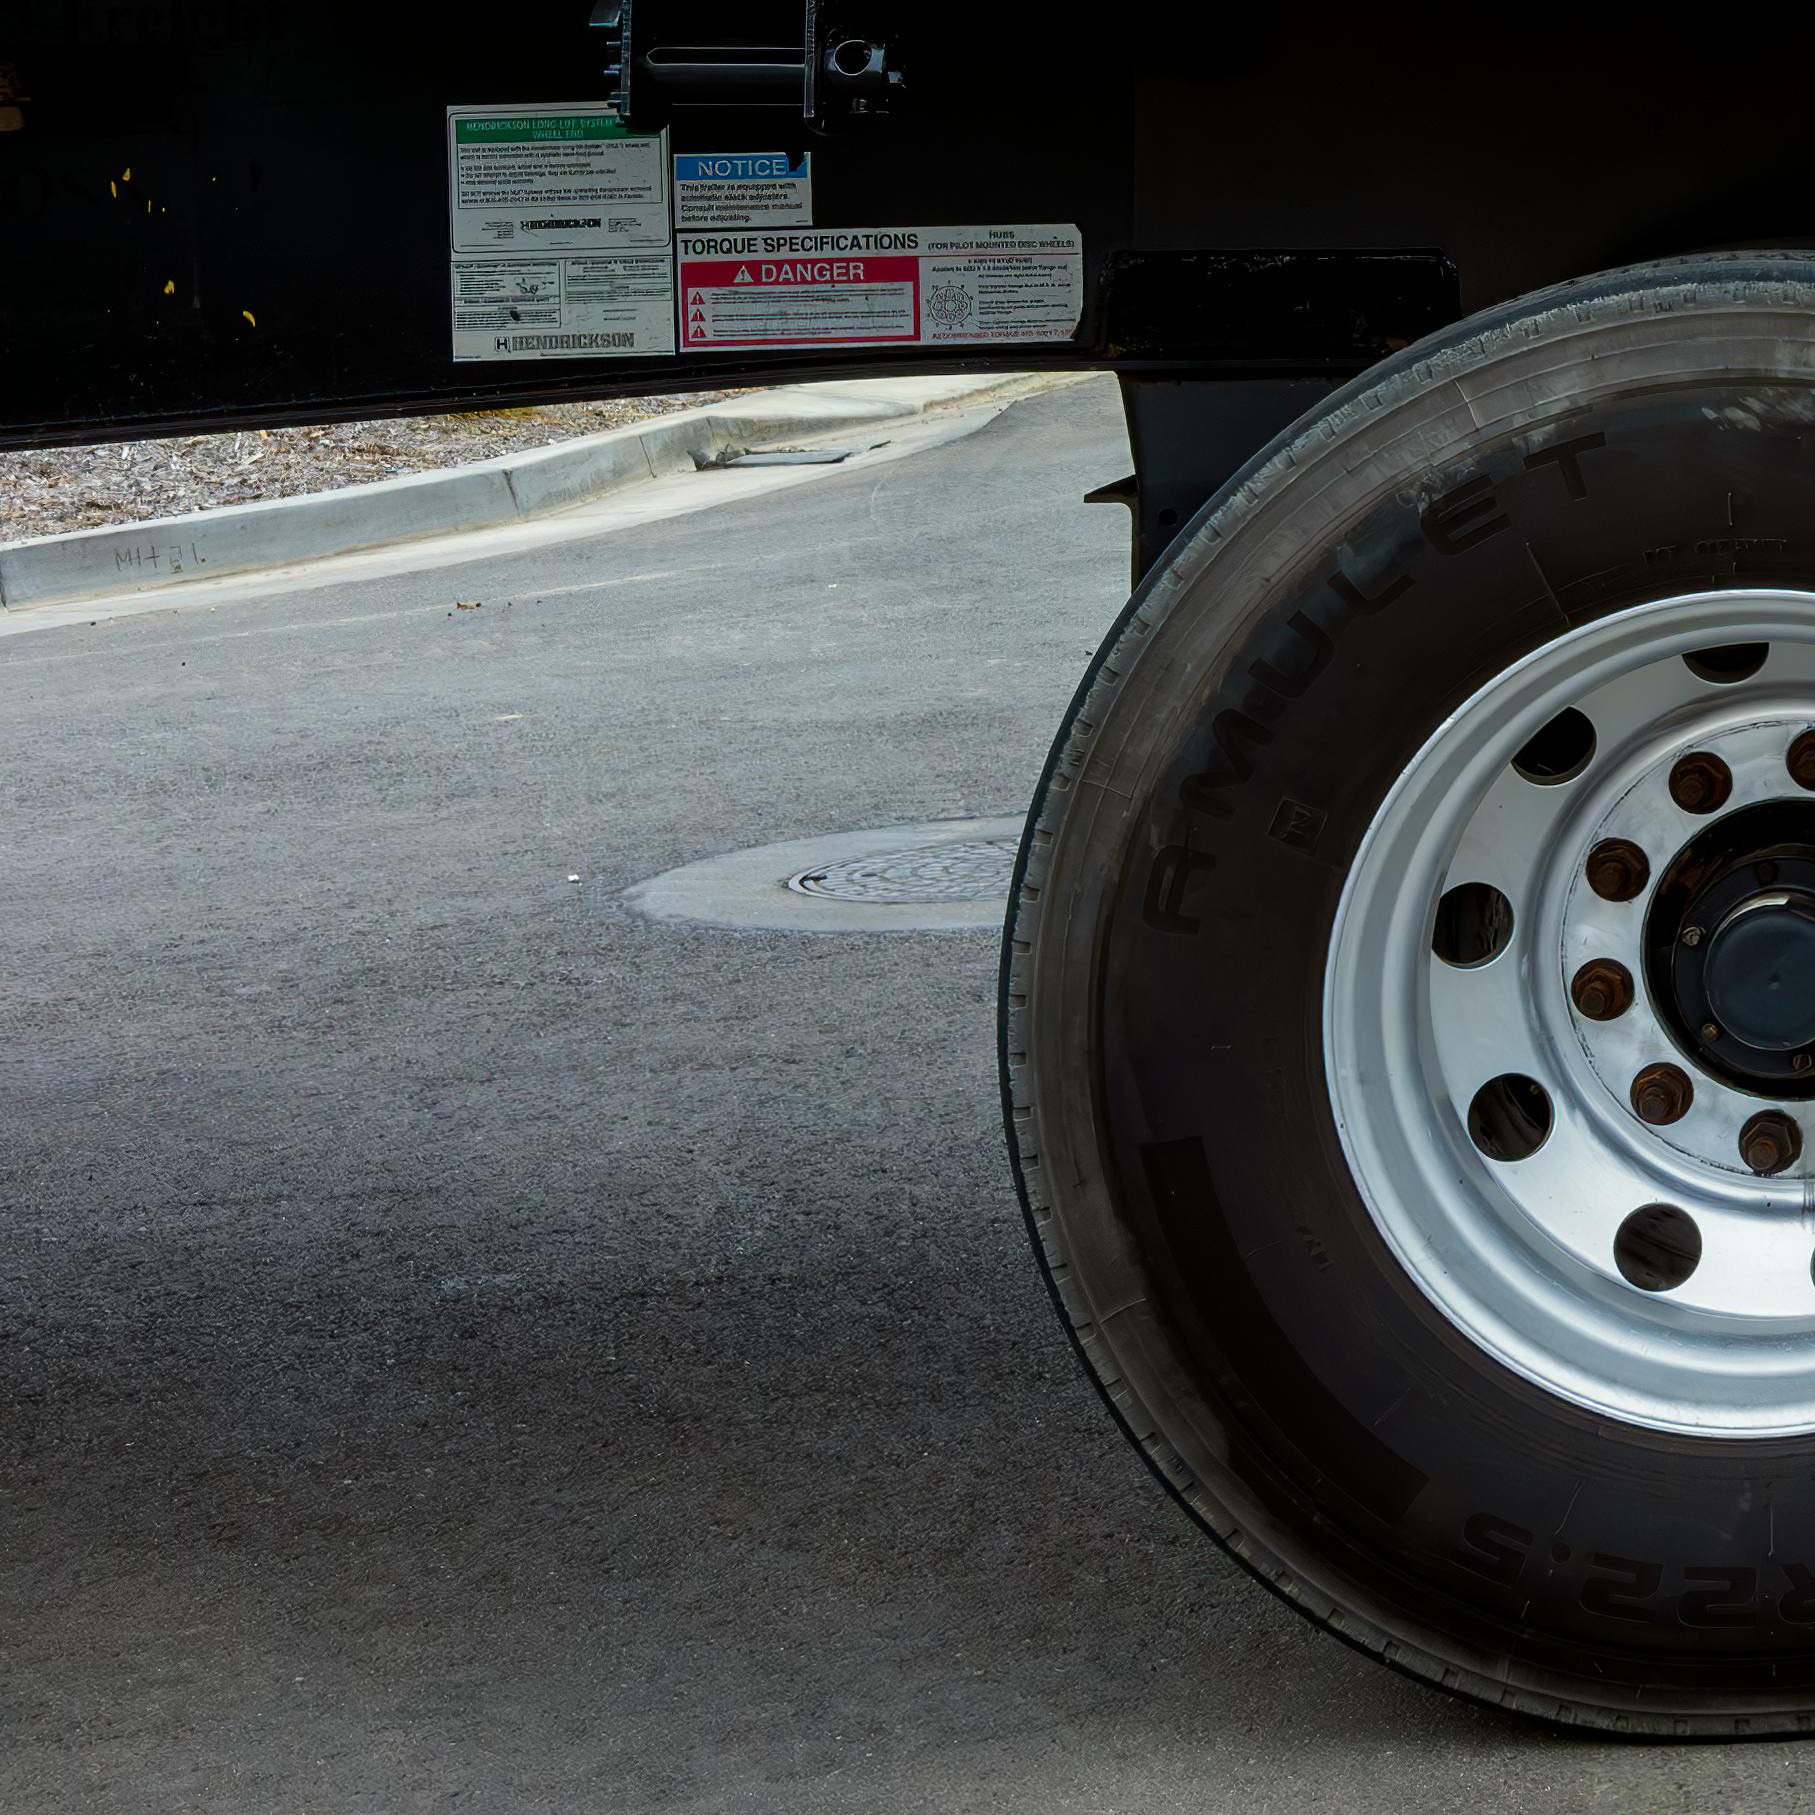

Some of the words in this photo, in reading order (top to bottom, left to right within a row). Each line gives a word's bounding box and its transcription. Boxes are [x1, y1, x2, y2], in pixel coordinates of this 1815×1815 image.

[698, 159, 788, 177] NOTICE
[681, 237, 758, 255] TORQUE
[763, 233, 920, 253] SPECIFICATIONS
[760, 262, 866, 282] DANGER
[511, 332, 636, 350] HENDRICKSON
[1143, 431, 1609, 937] AMULET
